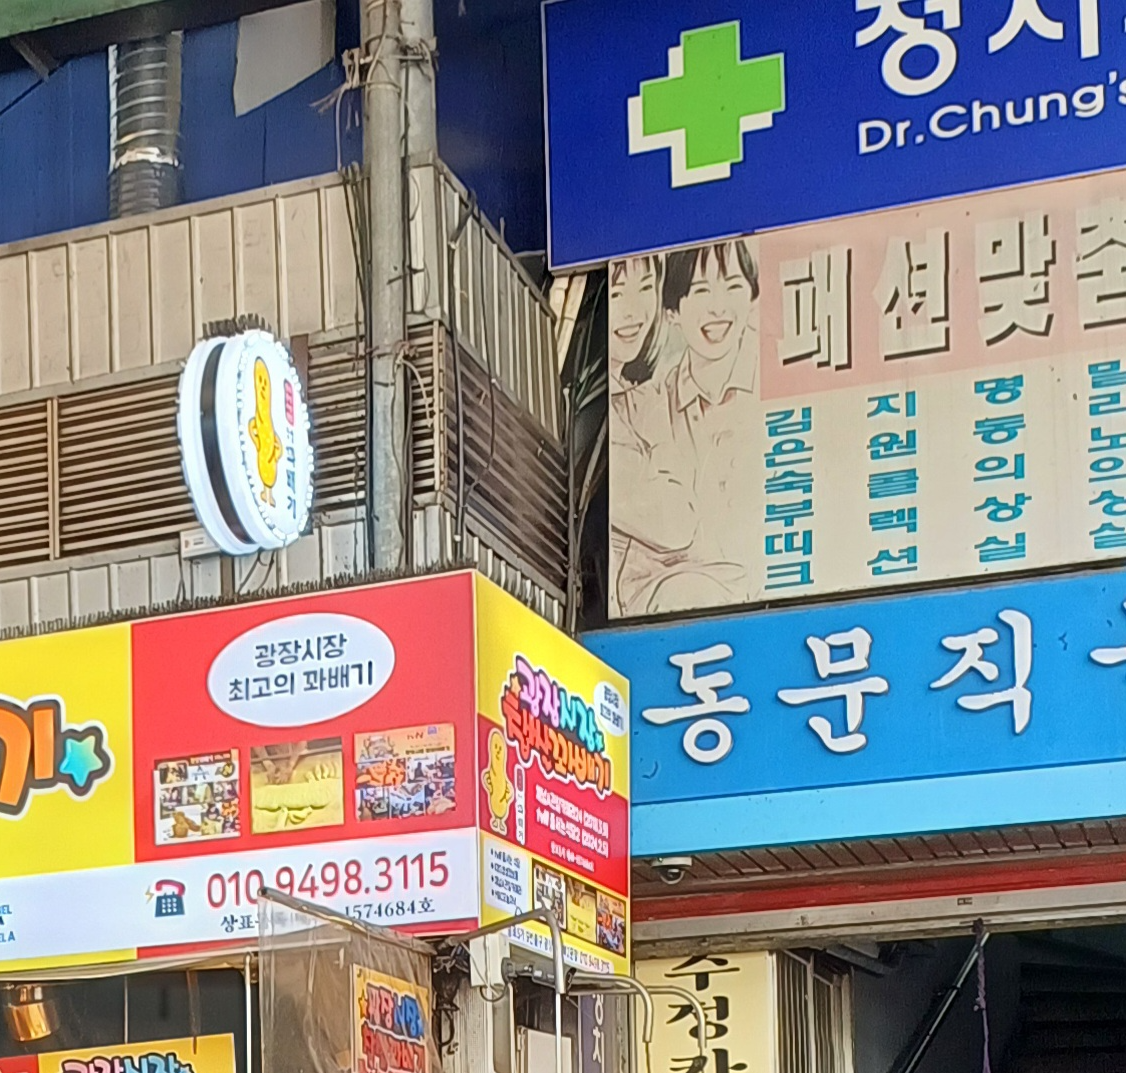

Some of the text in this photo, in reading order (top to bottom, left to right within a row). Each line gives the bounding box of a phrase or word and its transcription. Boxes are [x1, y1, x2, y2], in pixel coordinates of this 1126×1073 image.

[973, 374, 1032, 563] 명동의상실
[254, 632, 348, 668] 광장시장
[228, 660, 373, 704] 최고의 꽈배기
[641, 600, 1126, 764] 동문직
[207, 850, 450, 910] 0109498.3115
[7, 930, 17, 943] A
